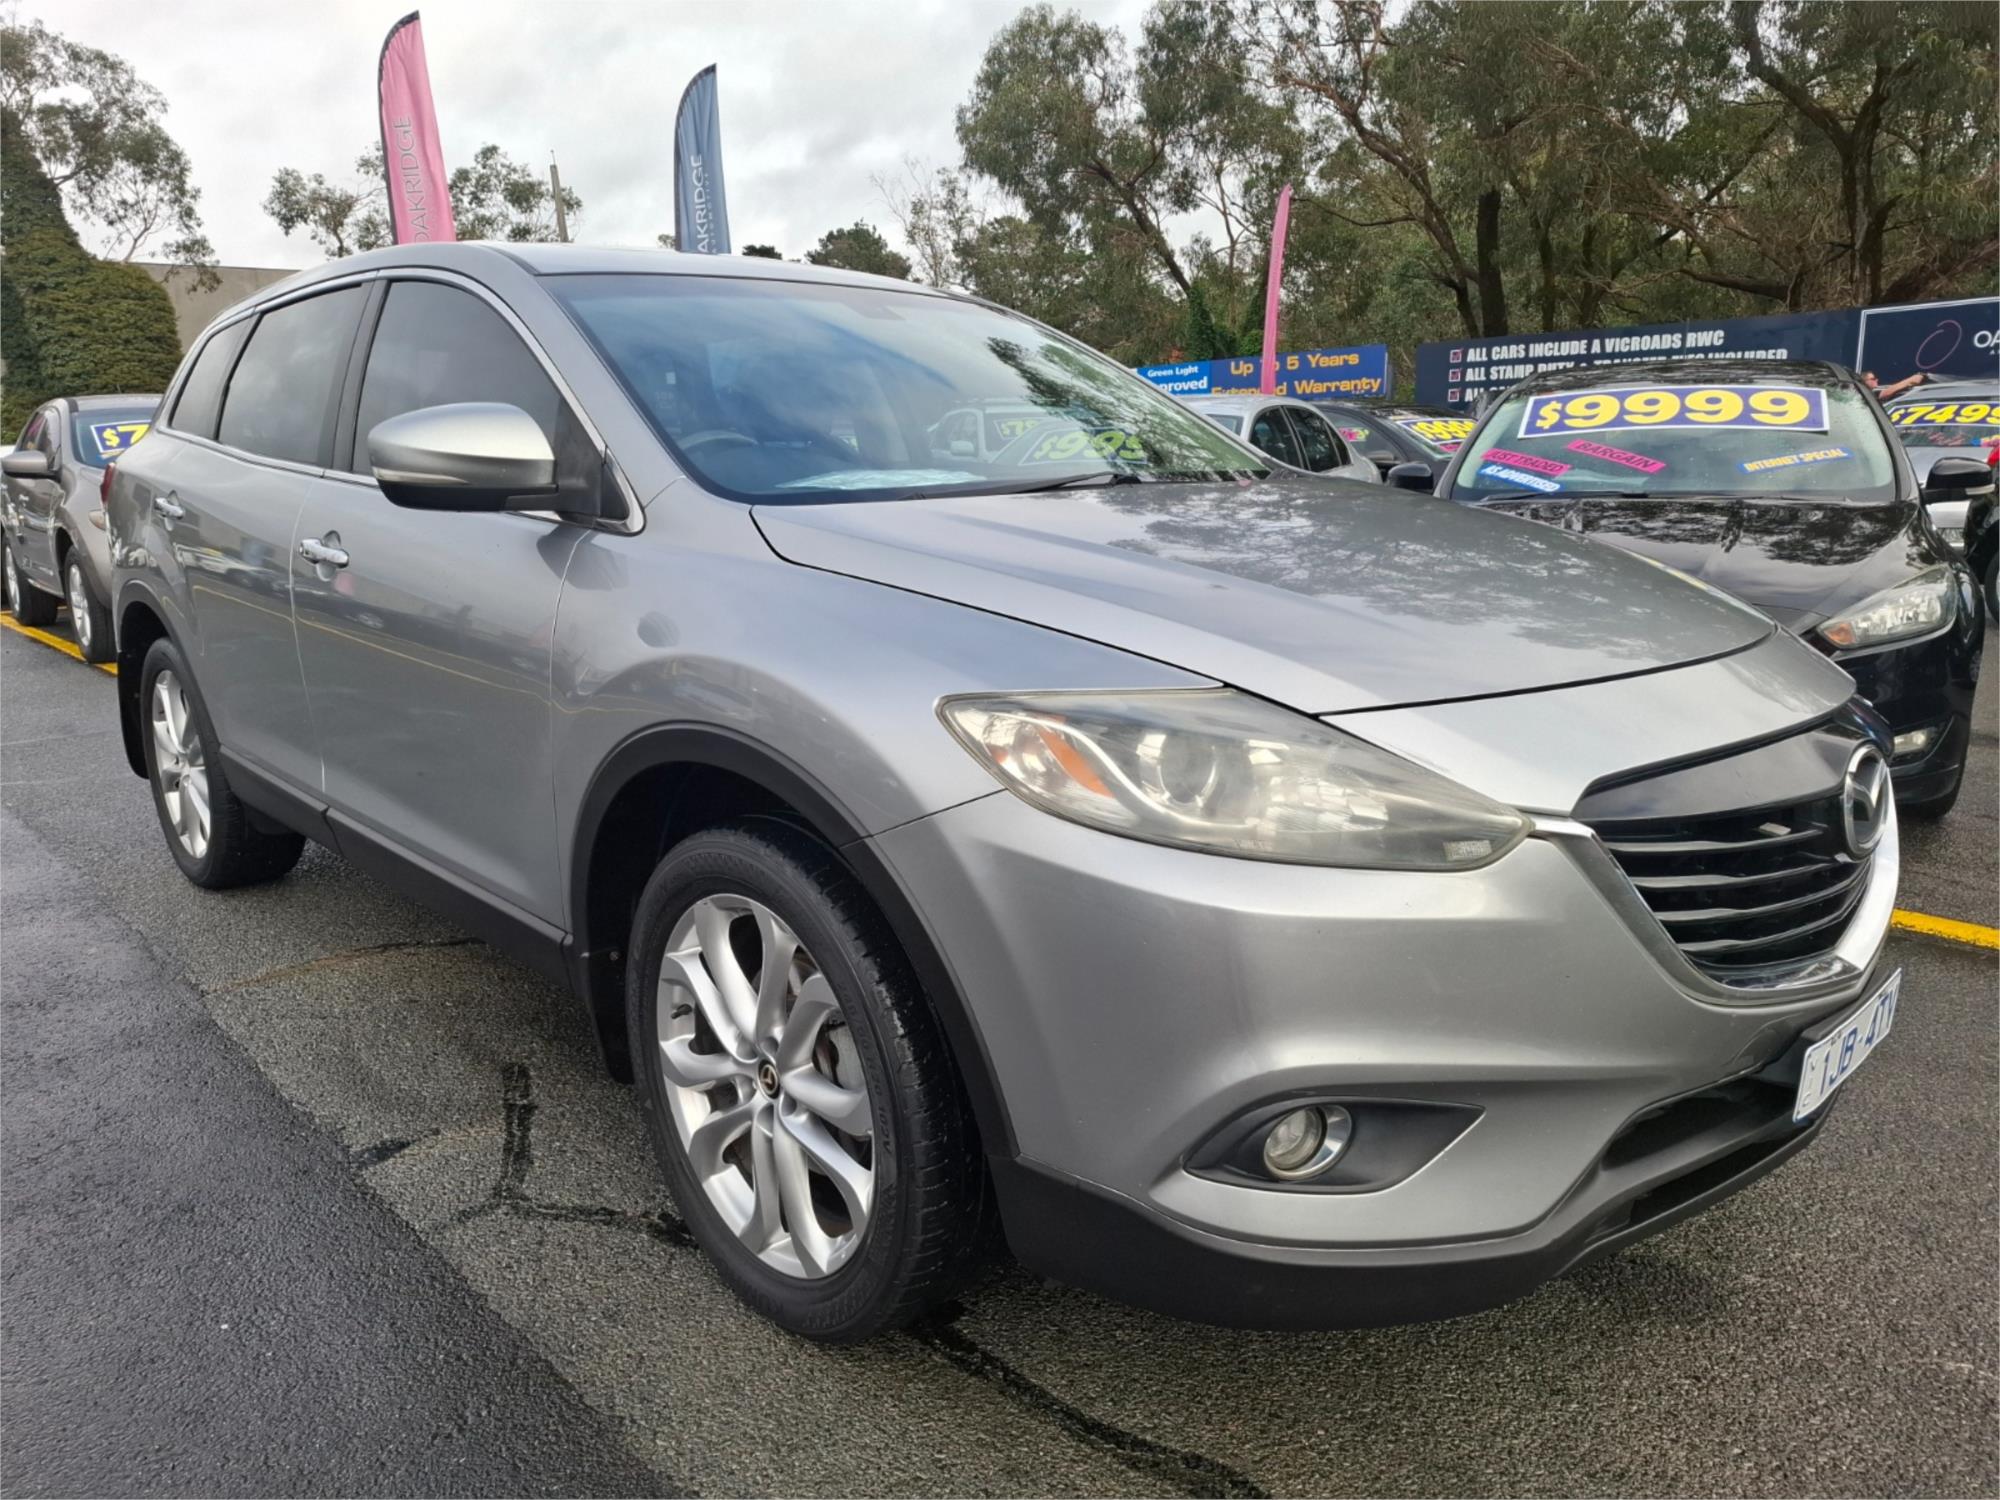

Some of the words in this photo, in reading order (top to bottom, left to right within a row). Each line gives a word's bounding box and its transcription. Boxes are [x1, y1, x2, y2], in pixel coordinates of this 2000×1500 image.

[1466, 347, 1489, 362] ALL
[1491, 344, 1526, 360] CARS
[1528, 340, 1588, 358] INCLUDE
[1590, 339, 1601, 354] A
[1603, 333, 1682, 354] VICROADS
[1685, 330, 1725, 348] RWC
[1147, 369, 1174, 378] Green
[1175, 365, 1200, 376] Light
[1231, 360, 1254, 376] Up
[1286, 355, 1300, 370] 5
[1307, 353, 1360, 368] Years
[1465, 367, 1487, 382] ALL
[1489, 363, 1535, 380] STAMP
[1294, 377, 1382, 395] Warranty
[1535, 389, 1811, 430] $9999
[1575, 442, 1655, 469] BARGAIN
